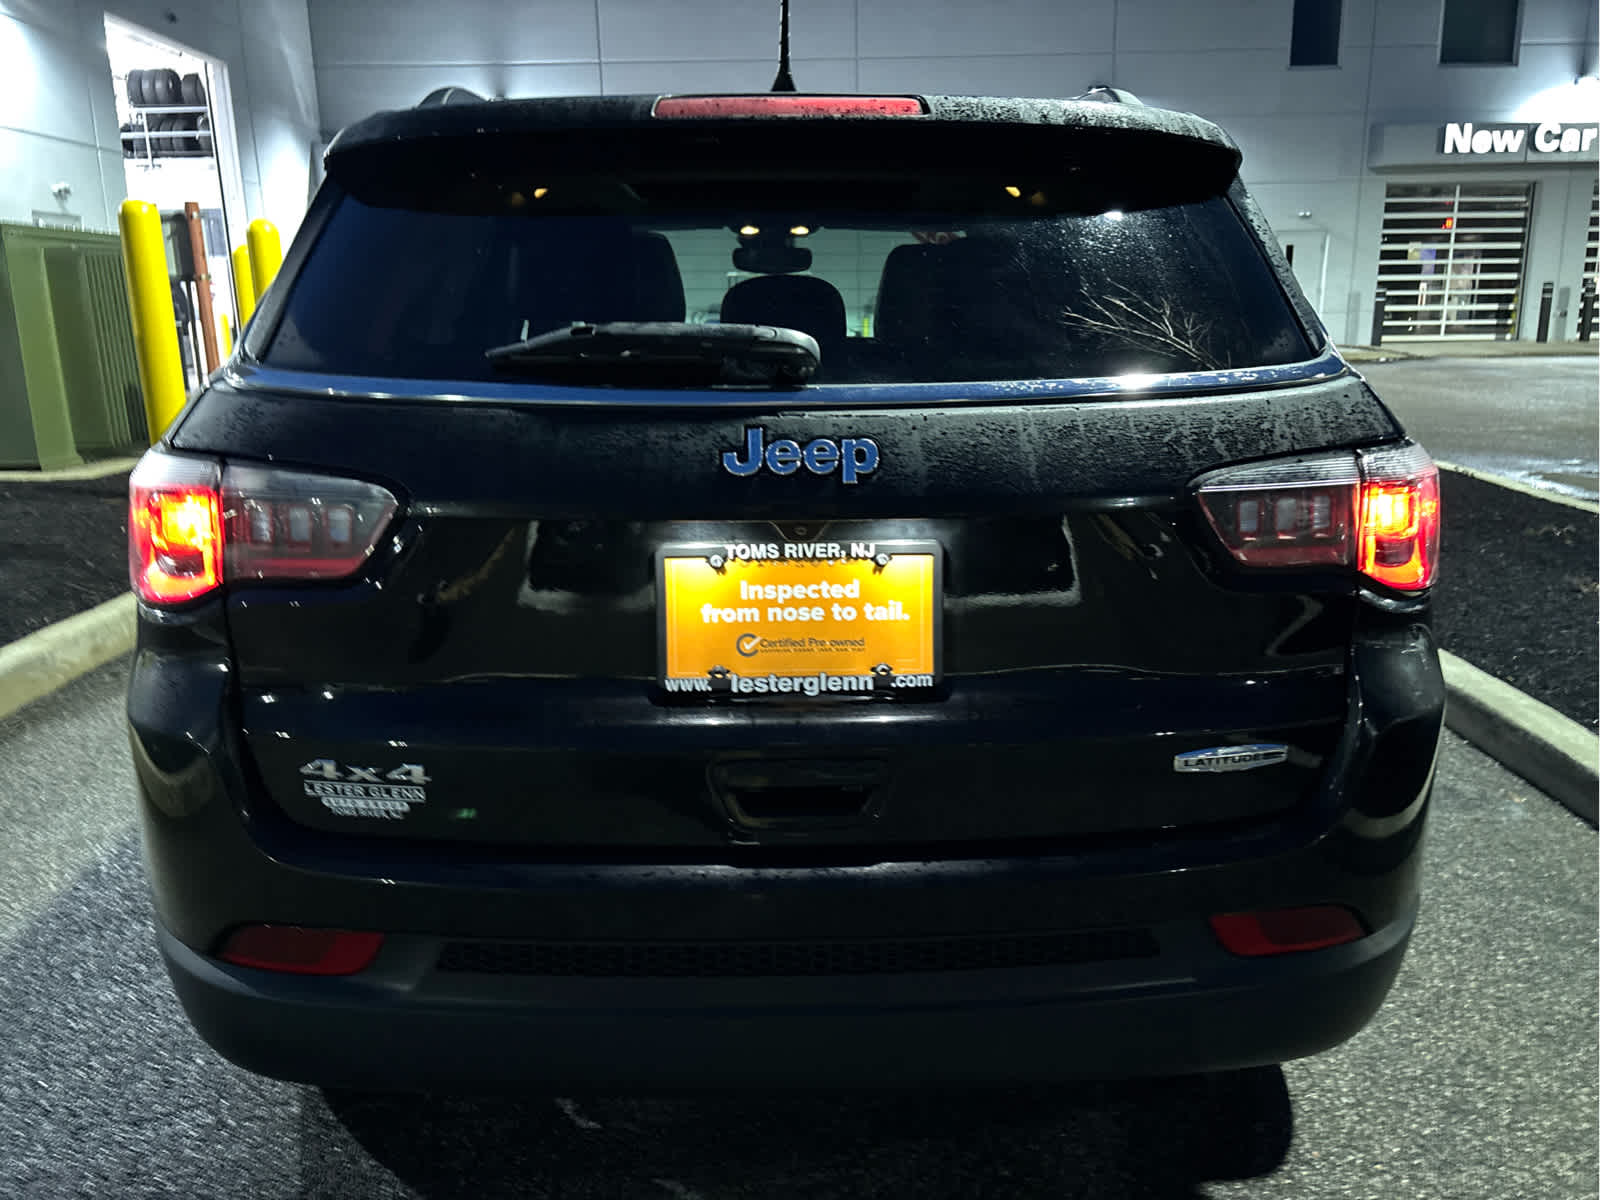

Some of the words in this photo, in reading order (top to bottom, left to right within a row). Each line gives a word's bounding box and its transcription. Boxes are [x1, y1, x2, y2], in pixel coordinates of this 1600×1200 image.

[1534, 122, 1599, 153] Car
[722, 426, 880, 484] Jeep
[724, 543, 779, 560] TOMS
[784, 543, 847, 559] RIVER,
[850, 542, 876, 558] NJ
[740, 579, 860, 604] Inspected
[700, 603, 760, 624] from
[767, 606, 825, 621] nose
[831, 602, 857, 621] to
[863, 599, 911, 621] tail.
[760, 637, 806, 648] Certified
[730, 672, 875, 697] lesterglenn
[304, 782, 366, 798] LESTER
[367, 785, 425, 801] GLENN
